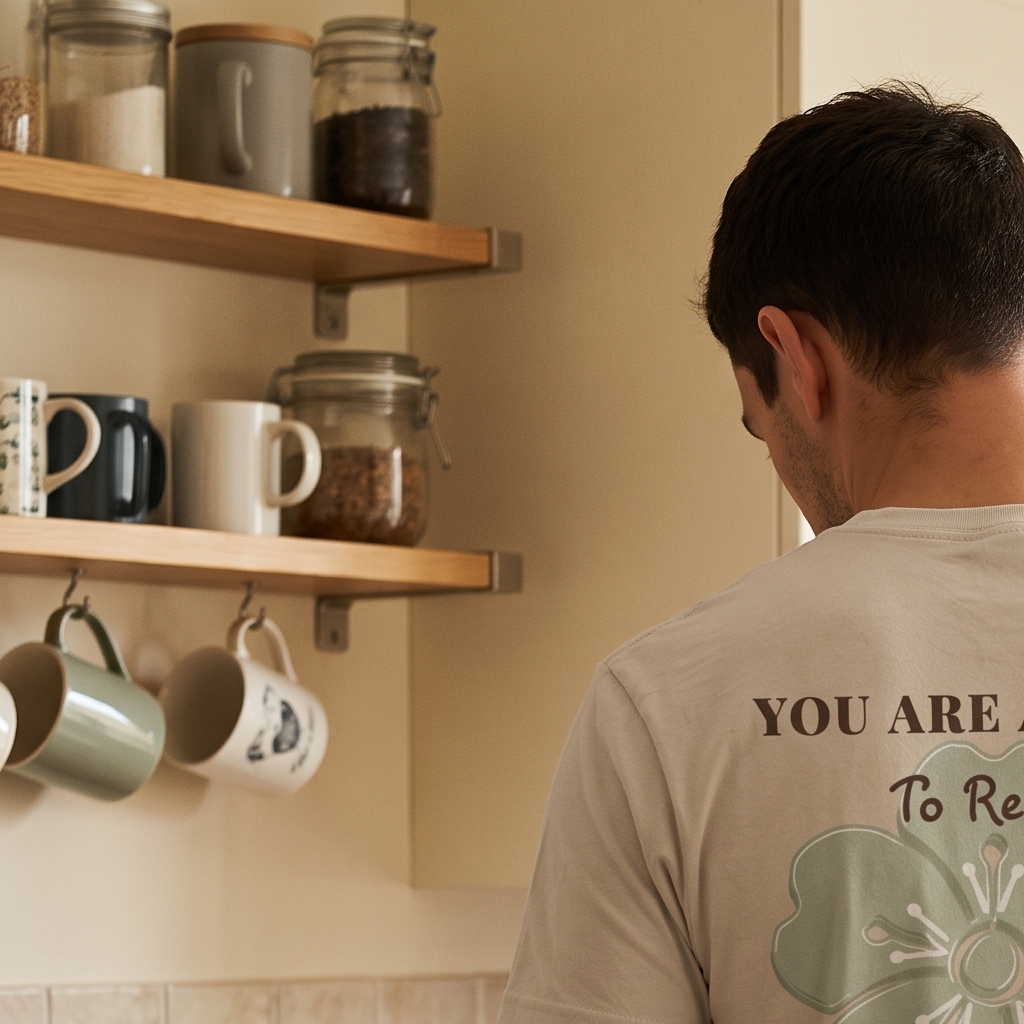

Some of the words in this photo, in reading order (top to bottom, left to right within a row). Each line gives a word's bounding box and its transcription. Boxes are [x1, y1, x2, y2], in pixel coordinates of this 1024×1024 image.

[753, 696, 870, 737] YOU
[888, 694, 1001, 734] ARE
[889, 774, 944, 823] To
